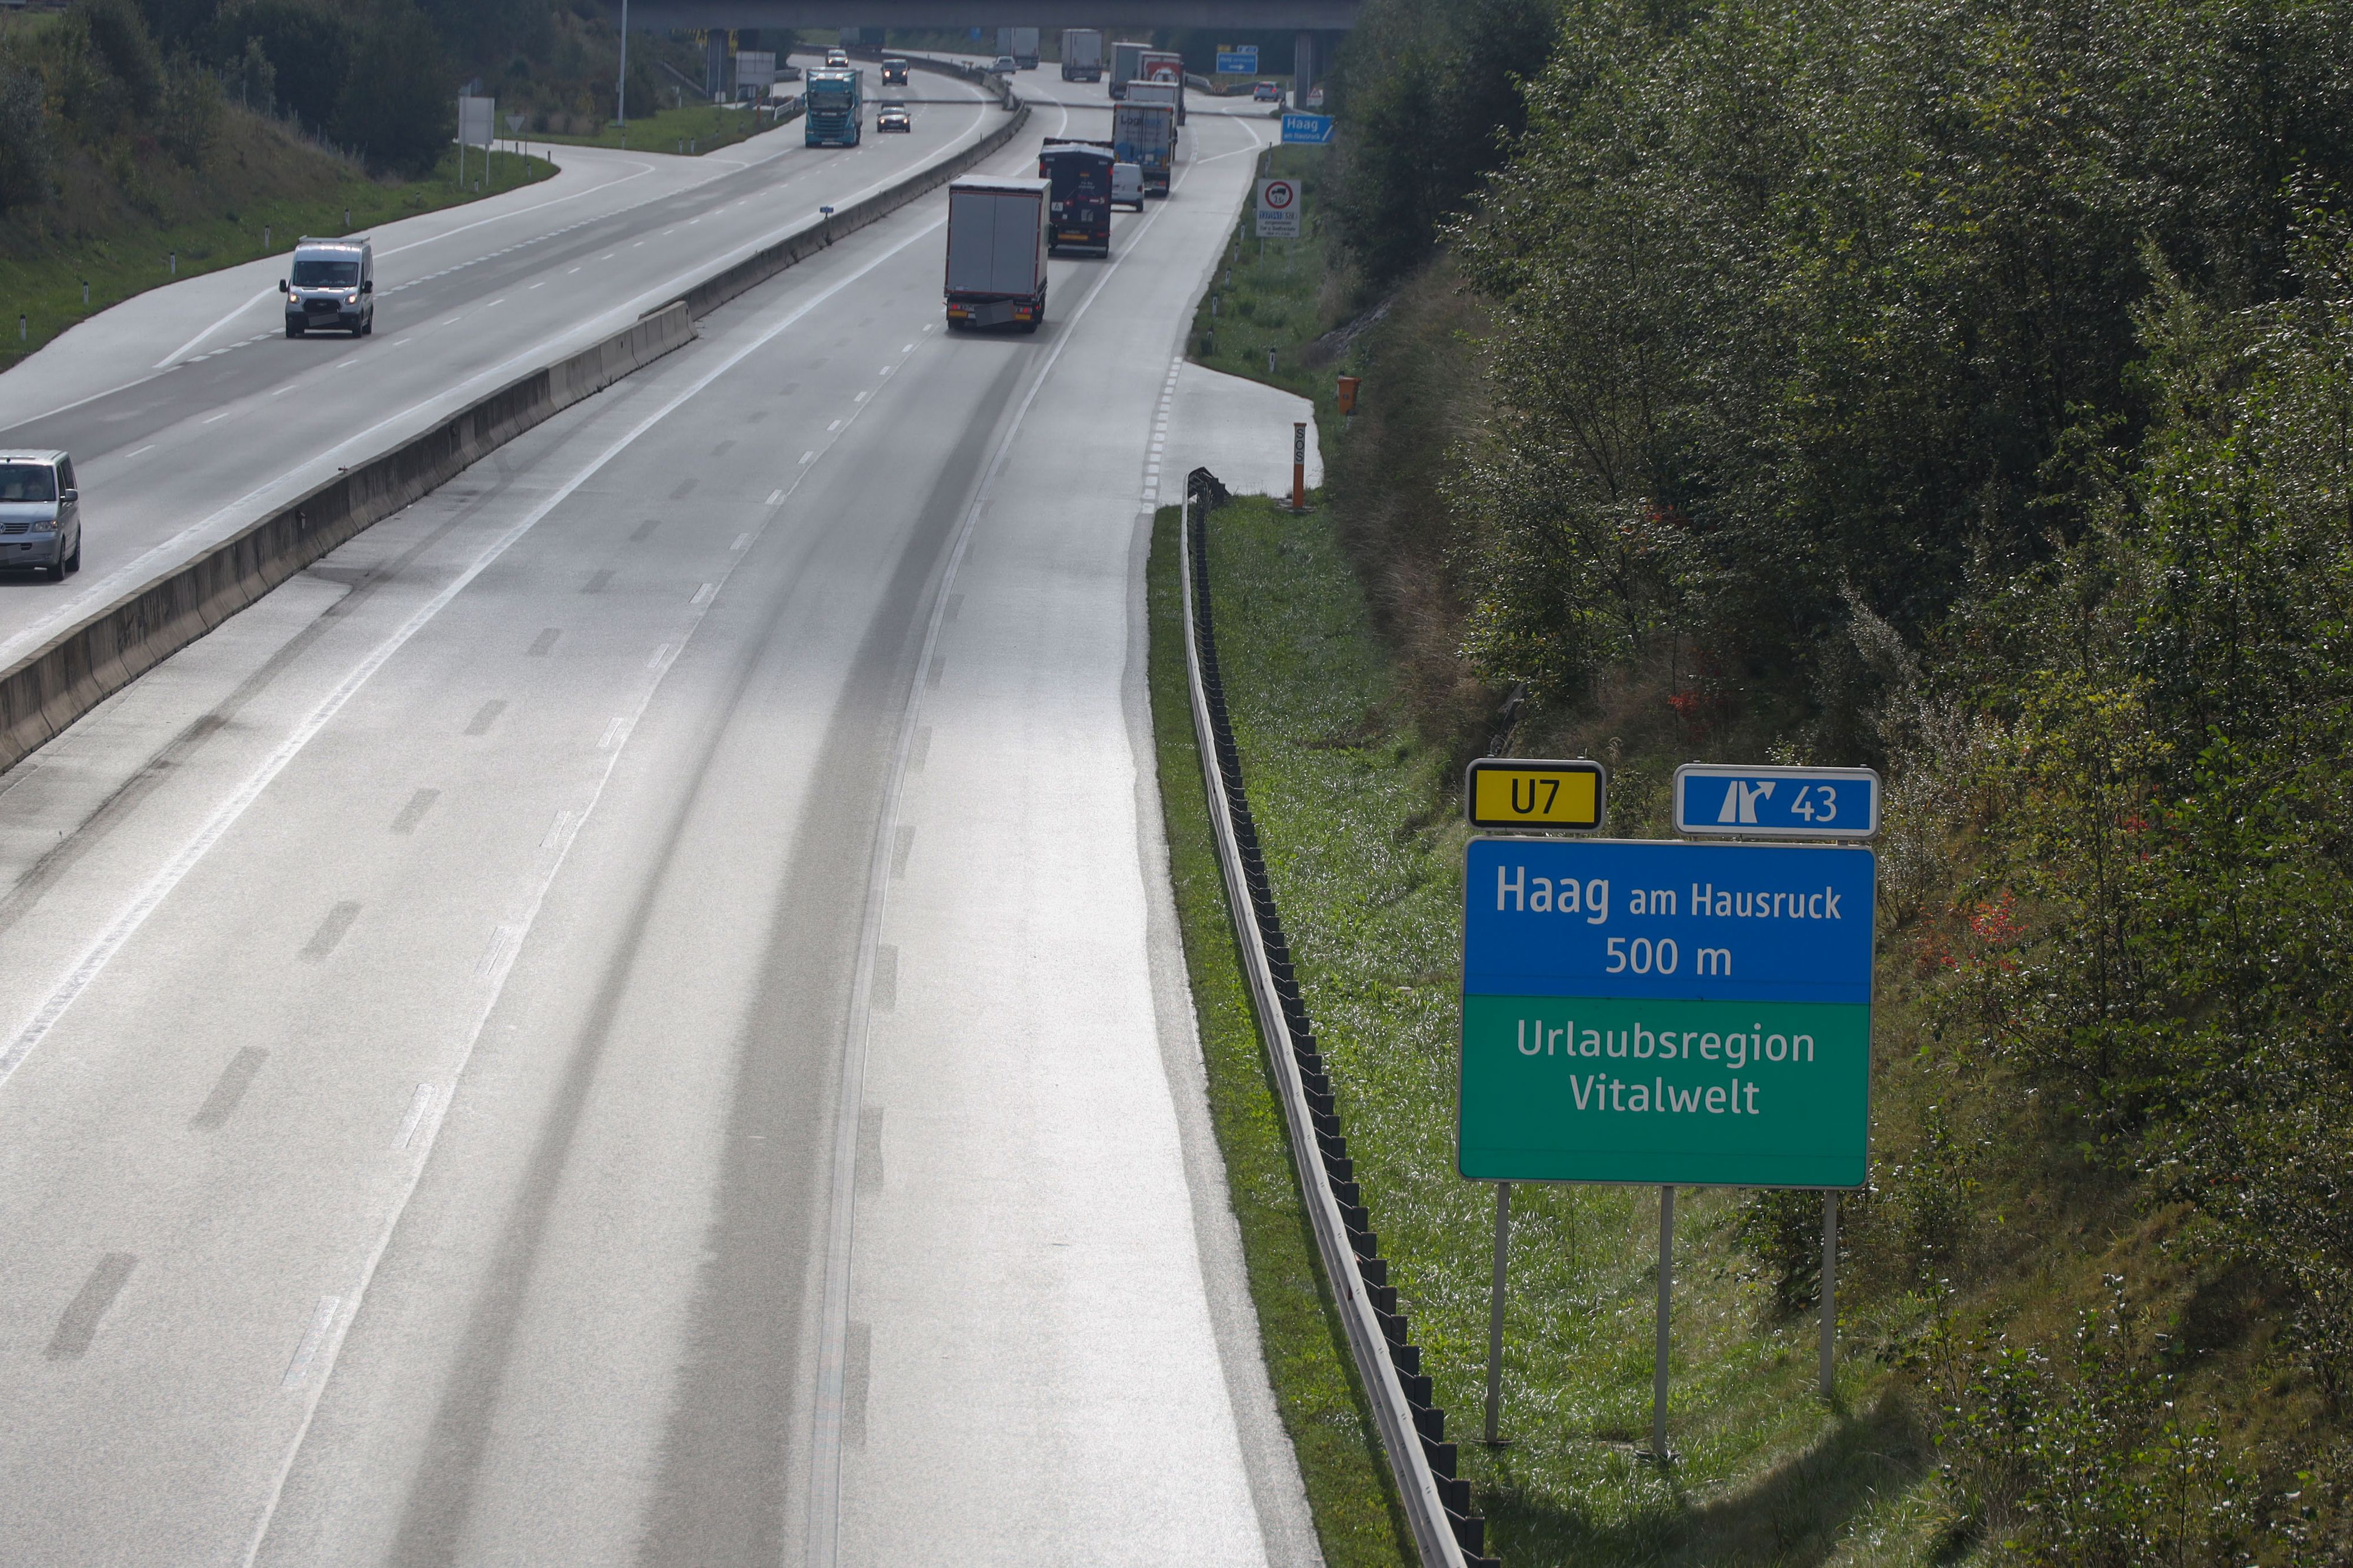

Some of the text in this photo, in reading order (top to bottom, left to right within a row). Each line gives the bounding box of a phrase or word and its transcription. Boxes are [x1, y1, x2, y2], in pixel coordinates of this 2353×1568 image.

[1287, 117, 1318, 132] Haag
[1295, 428, 1304, 462] SOS
[1511, 778, 1560, 815] U7
[1790, 785, 1837, 822] 43
[1496, 865, 1842, 925] Haag am Hausruck
[1605, 937, 1731, 976] 500 m
[1517, 1019, 1814, 1069] Urlaubsregion
[1569, 1073, 1760, 1115] Vitalwelt
